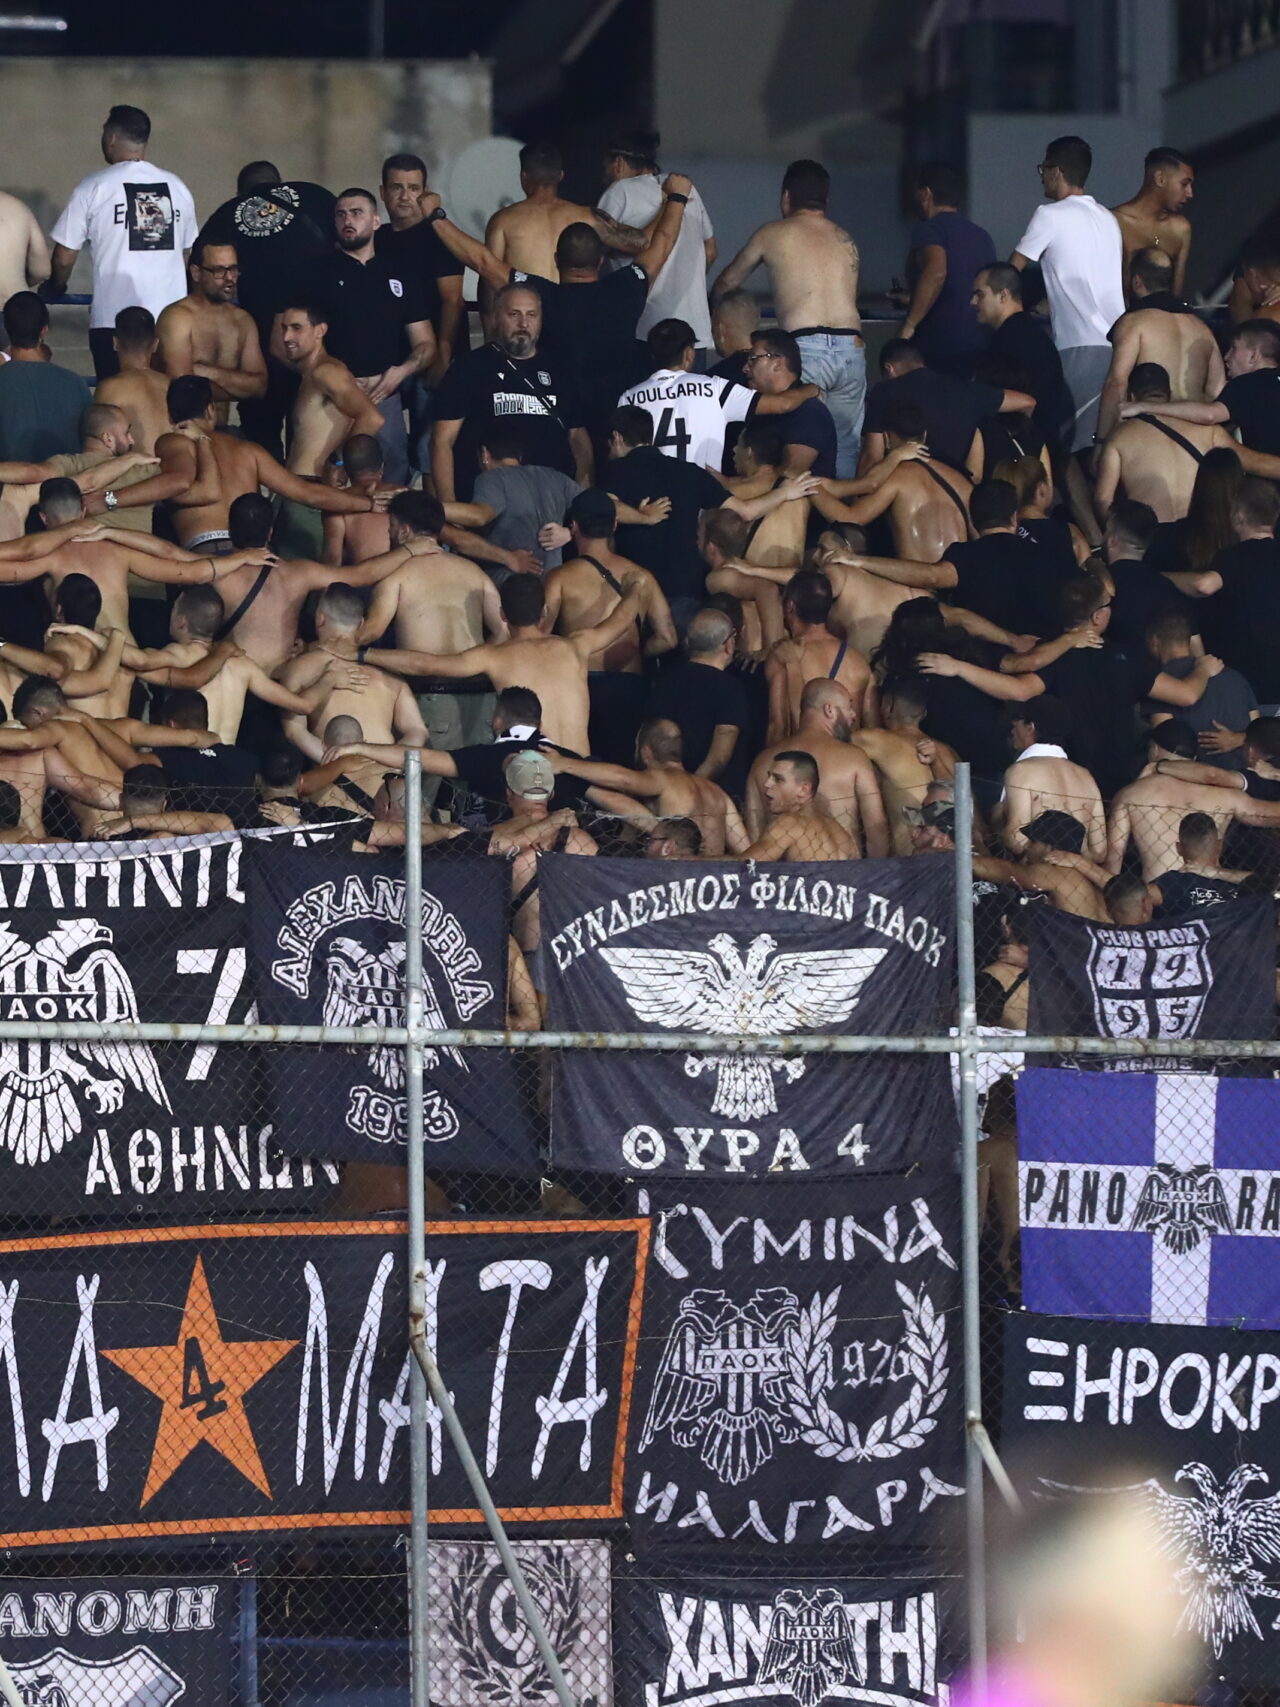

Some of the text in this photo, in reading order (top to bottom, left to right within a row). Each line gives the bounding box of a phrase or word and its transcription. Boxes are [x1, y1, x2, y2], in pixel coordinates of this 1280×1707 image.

[626, 382, 714, 405] VOULGARIS
[653, 408, 692, 461] 4
[549, 873, 947, 972] ΣΥΝΔΕΣΜΟΣ ΦΙΛΩΝ ΠΑΟΚ
[1096, 929, 1144, 947] CLUB
[622, 1123, 870, 1172] ΘΥΡΑ 4
[1025, 1167, 1127, 1226] PANO
[179, 1336, 225, 1421] 4
[701, 1352, 779, 1370] ΠΑΟΚ
[788, 1626, 834, 1640] ΠΑΟΚ
